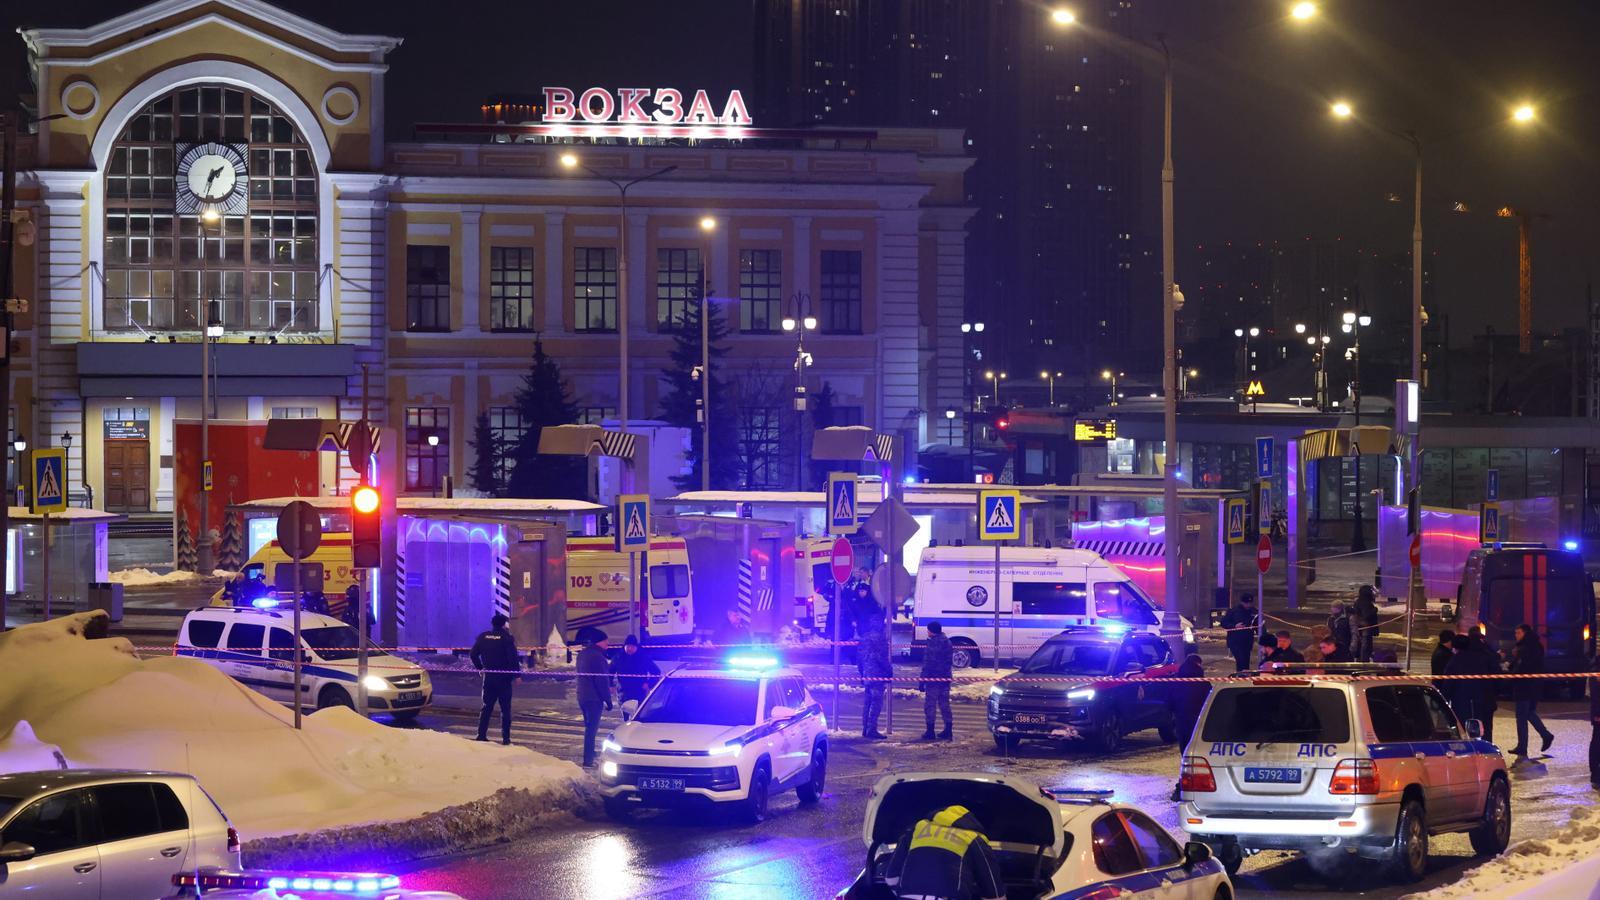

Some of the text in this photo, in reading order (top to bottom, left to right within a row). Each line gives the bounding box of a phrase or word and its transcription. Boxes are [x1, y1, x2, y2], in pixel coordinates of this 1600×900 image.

[542, 86, 753, 125] ВОКЗАЛ
[570, 575, 593, 588] 103
[1209, 742, 1337, 757] ДПС ДПС
[1258, 770, 1283, 780] 5792
[1288, 769, 1298, 778] 99
[650, 779, 670, 788] 5132
